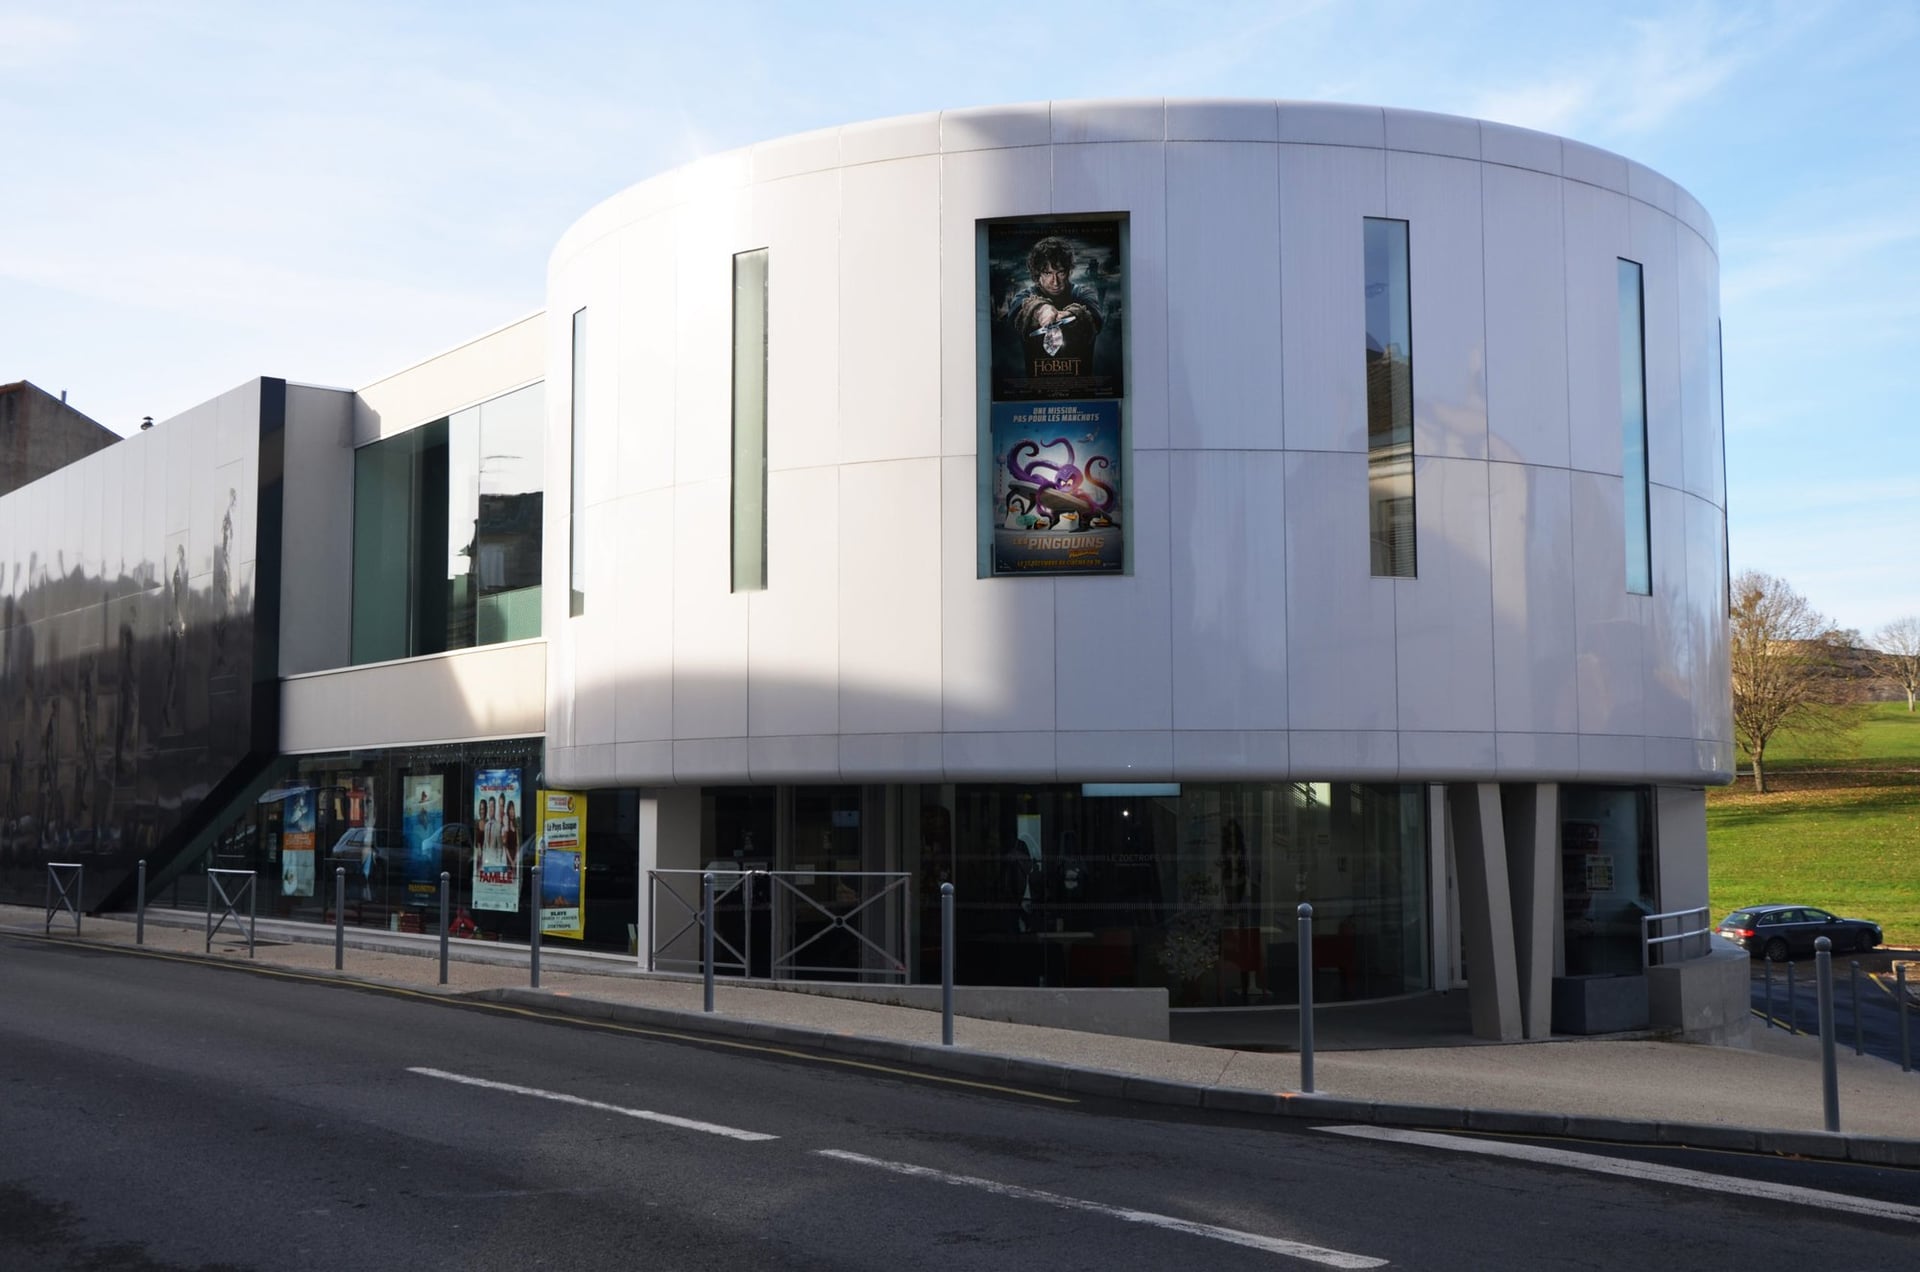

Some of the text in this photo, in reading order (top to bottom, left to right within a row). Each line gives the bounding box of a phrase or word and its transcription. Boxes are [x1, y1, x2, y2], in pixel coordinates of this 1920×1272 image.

[1034, 359, 1082, 377] HOBBIT
[1013, 413, 1100, 423] PAS POUR LES MANCHOTS
[1027, 535, 1105, 550] PINGOUINS
[480, 870, 513, 884] FAMILLE
